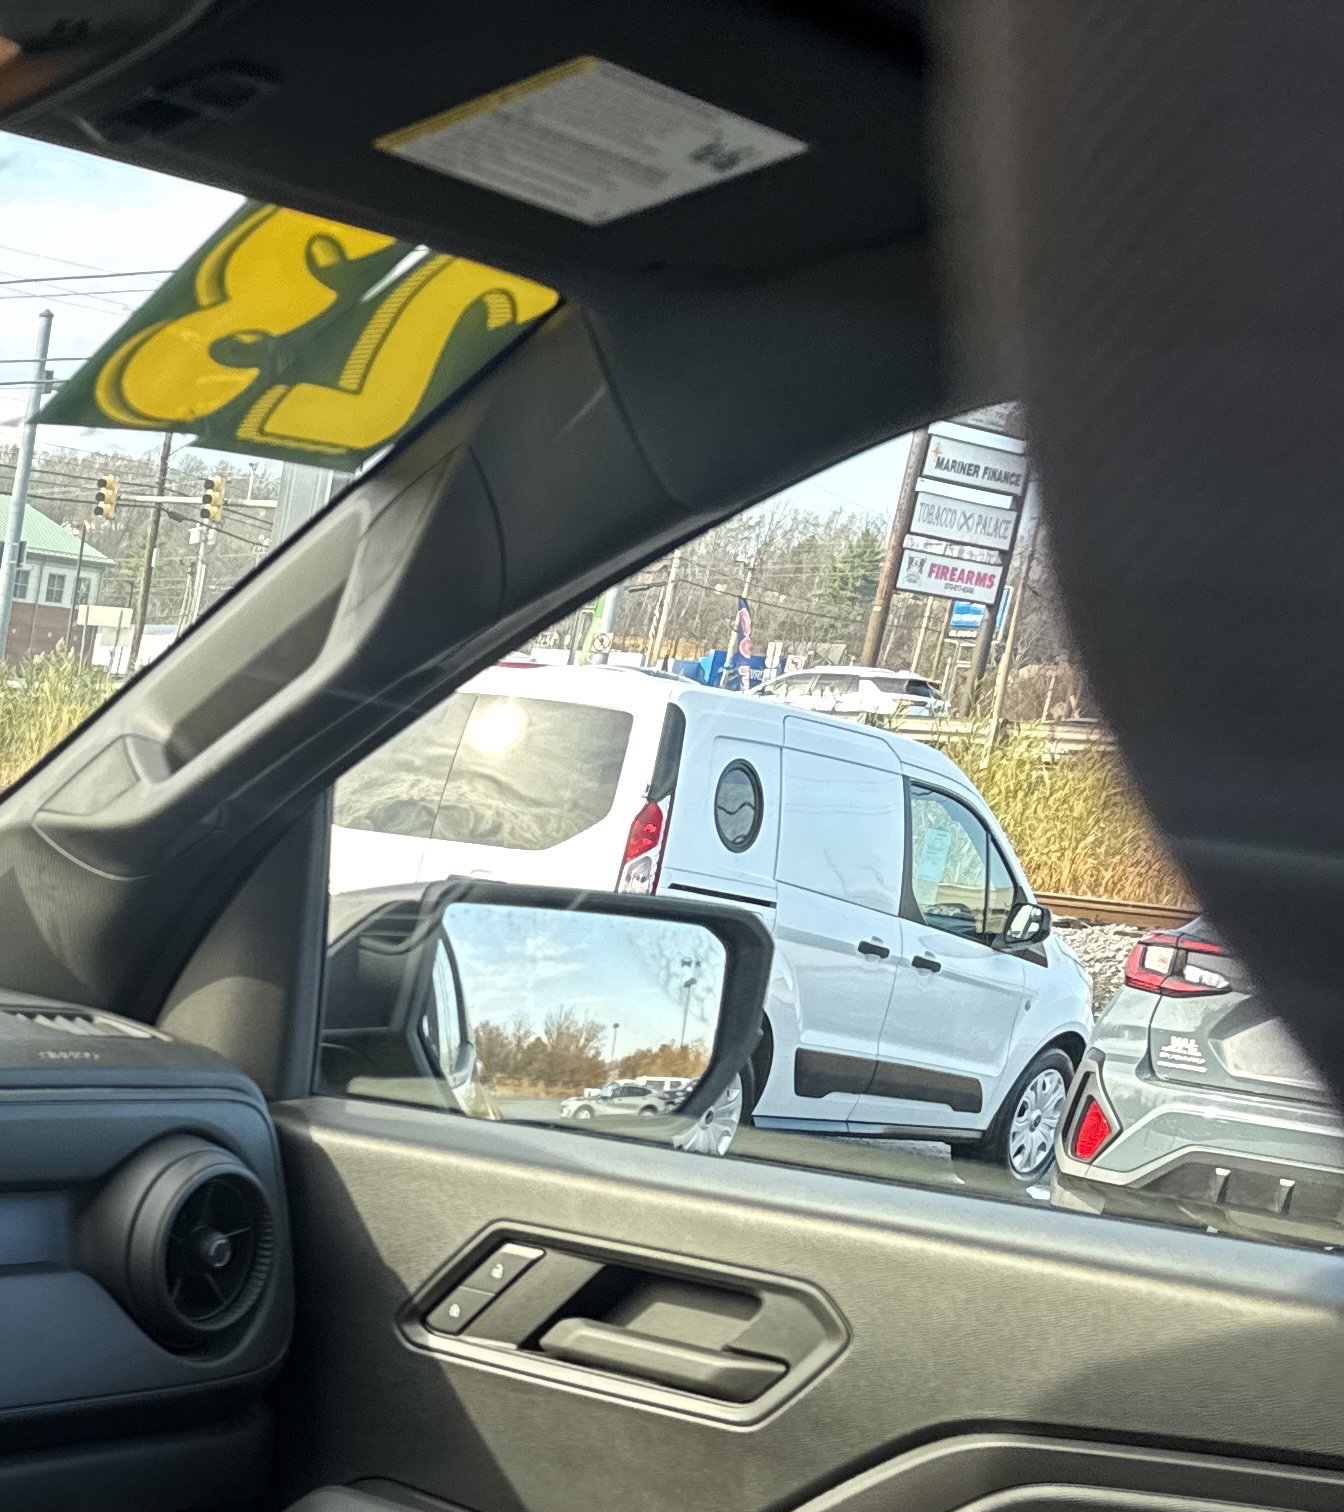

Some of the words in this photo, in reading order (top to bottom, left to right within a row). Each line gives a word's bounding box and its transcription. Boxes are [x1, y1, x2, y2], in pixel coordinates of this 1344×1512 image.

[935, 456, 981, 479] MARINER
[982, 465, 1022, 487] FINANCE
[918, 502, 957, 530] TOBACCO
[975, 514, 1012, 539] PALACE
[927, 562, 997, 590] FIREARMS
